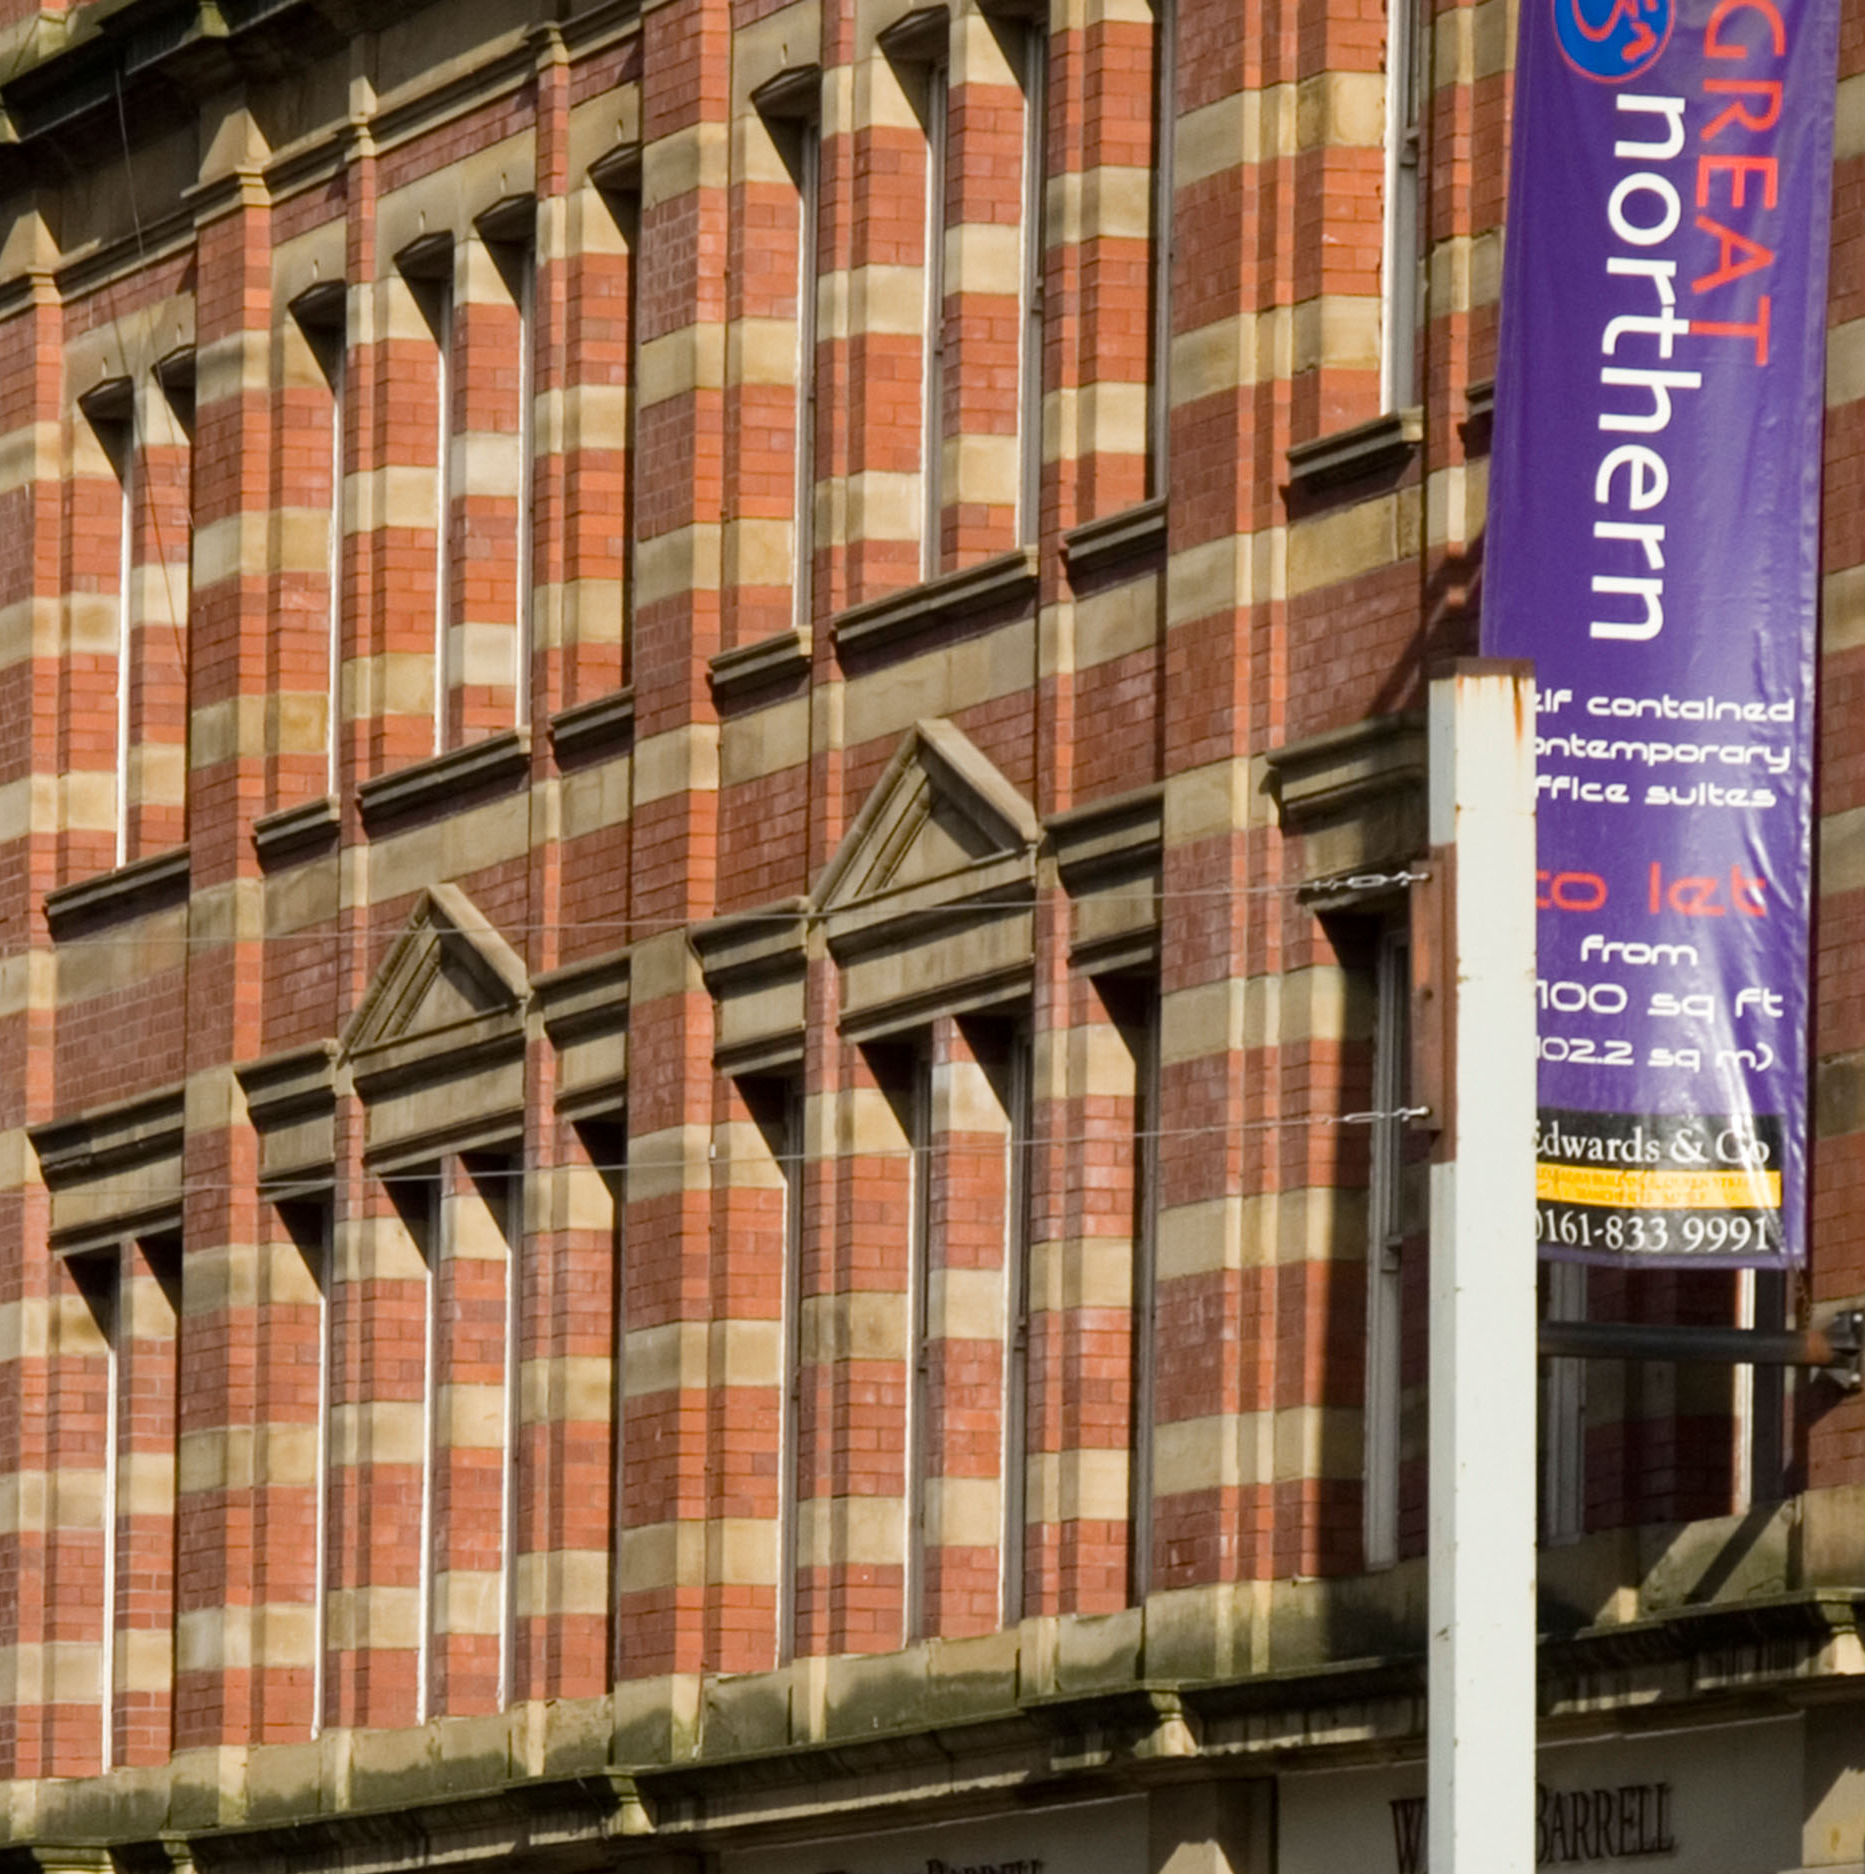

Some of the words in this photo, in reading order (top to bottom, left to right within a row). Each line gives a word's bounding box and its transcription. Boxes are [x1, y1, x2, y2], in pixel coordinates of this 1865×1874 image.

[1690, 0, 1786, 366] GREAT
[1590, 93, 1701, 641] northern
[1586, 694, 1795, 722] contained
[1535, 774, 1630, 803] ffice
[1645, 782, 1777, 807] suites
[1648, 861, 1767, 917] let
[1581, 934, 1698, 965] from
[1535, 980, 1629, 1015] 100
[1647, 991, 1716, 1023] sq
[1735, 987, 1784, 1018] ft
[1647, 1047, 1701, 1073] sq
[1716, 1041, 1775, 1072] m)
[1670, 1128, 1709, 1164] &
[1715, 1128, 1771, 1165] Co
[1682, 1216, 1770, 1252] 9991
